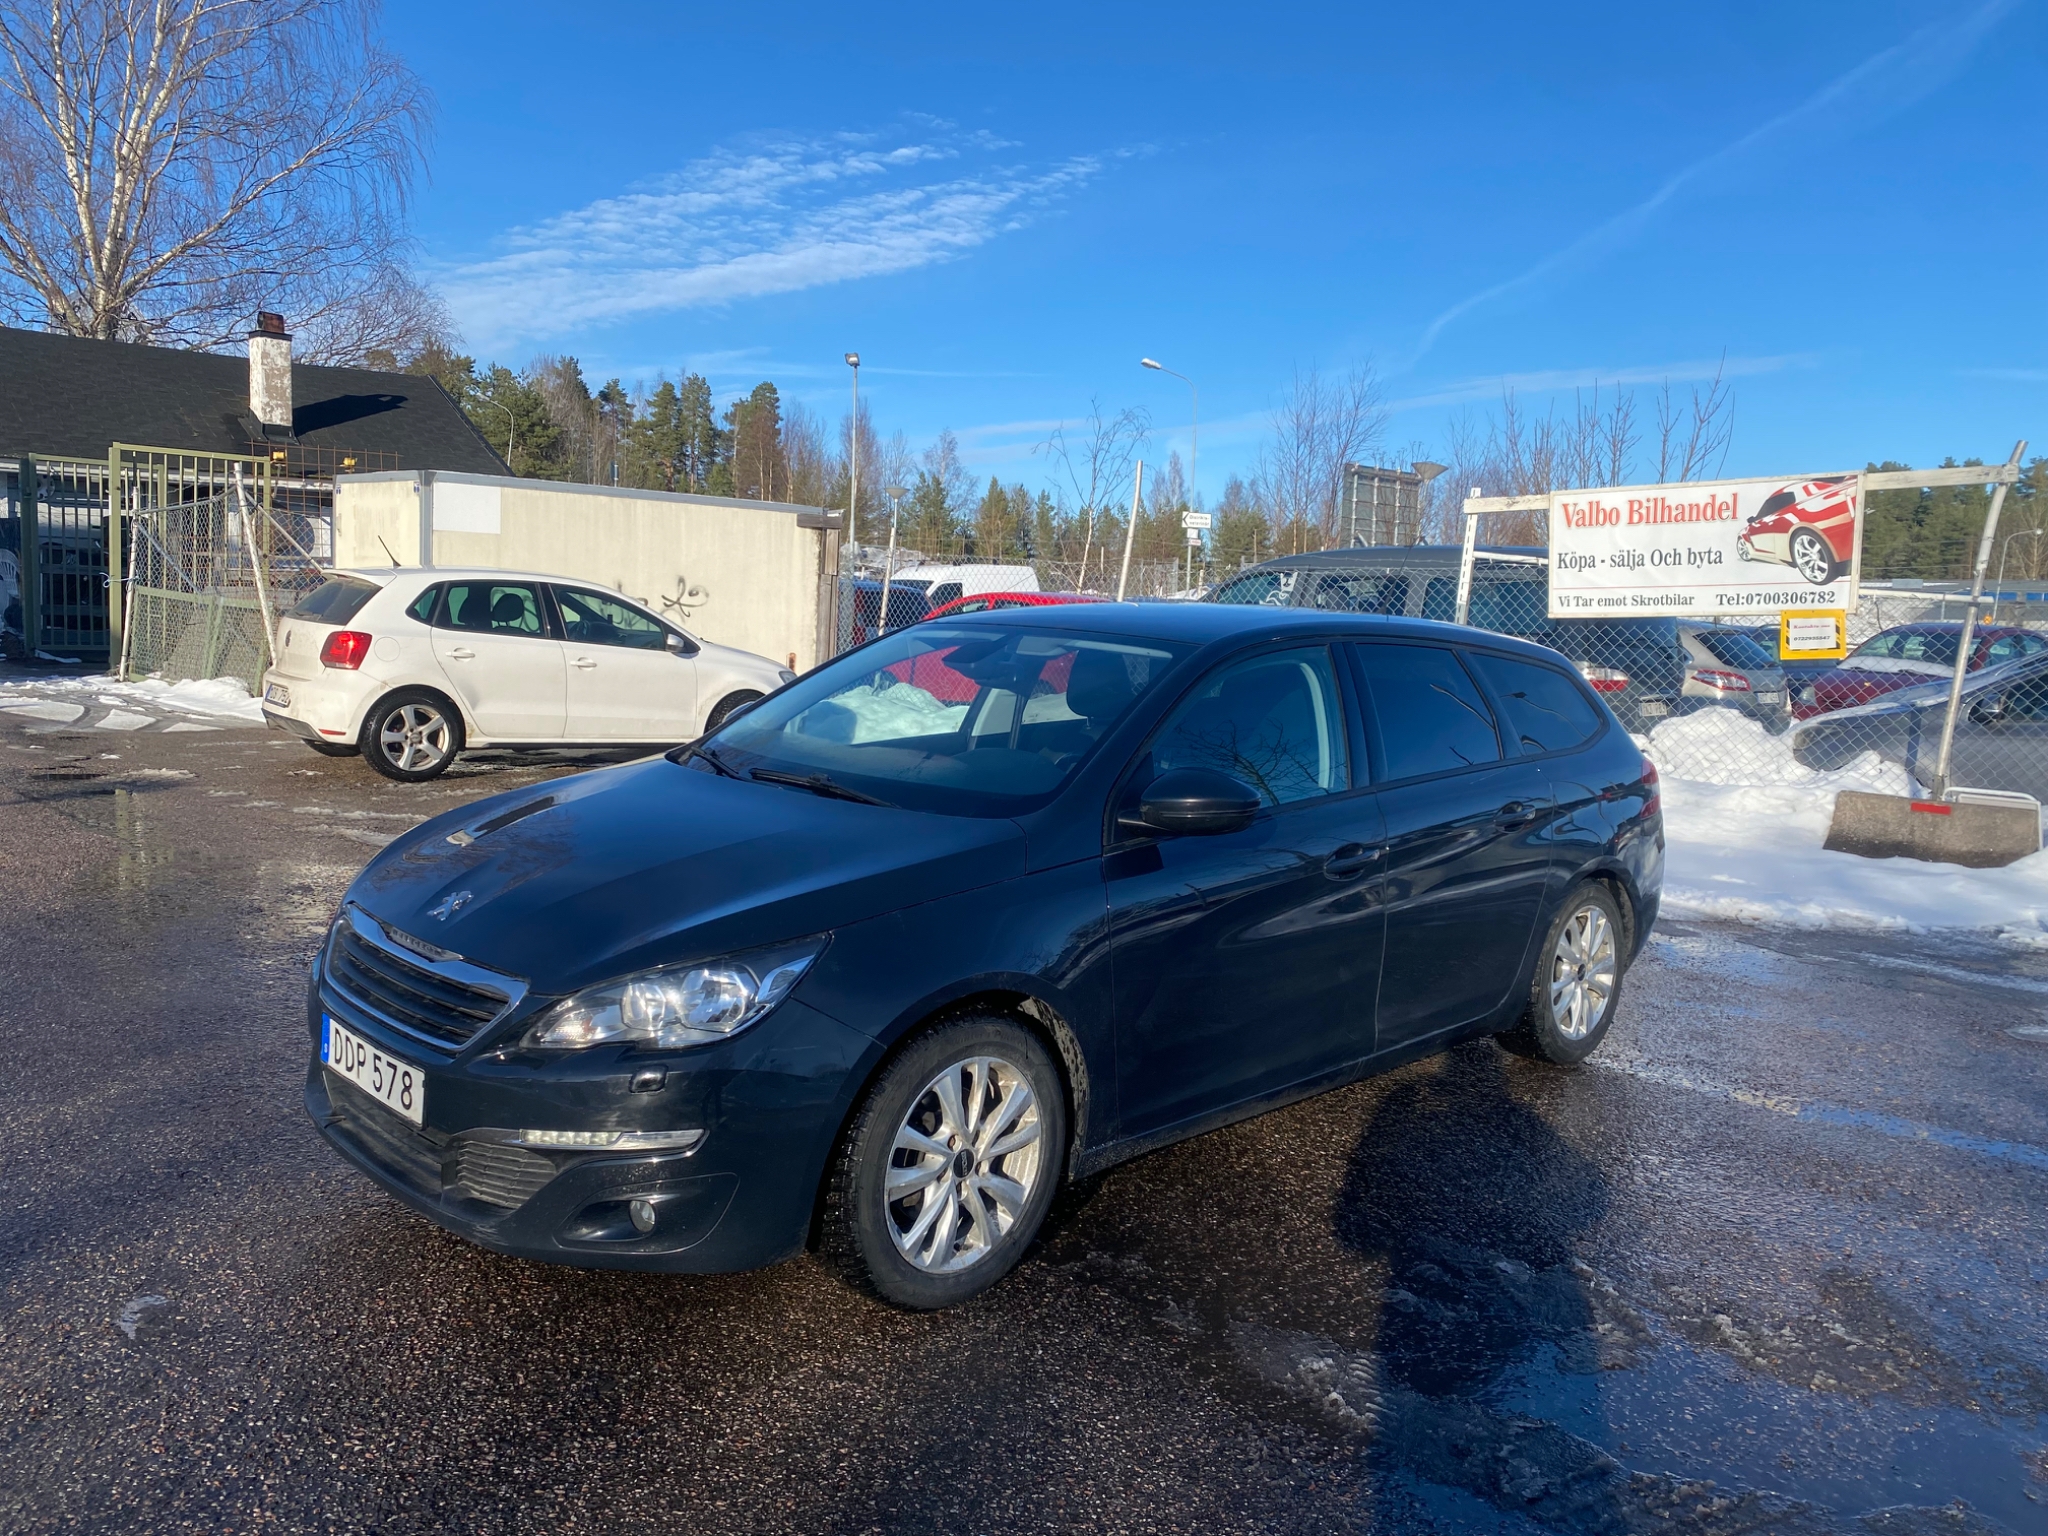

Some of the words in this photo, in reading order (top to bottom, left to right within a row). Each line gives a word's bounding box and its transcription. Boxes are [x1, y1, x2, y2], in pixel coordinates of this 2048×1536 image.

[1562, 500, 1621, 528] Valbo
[1627, 492, 1738, 525] Bilhandel
[1557, 551, 1596, 572] Köpa
[1610, 549, 1645, 571] sälja
[1651, 548, 1683, 567] Och
[1687, 547, 1723, 569] byta
[1558, 595, 1570, 607] Vi
[1573, 595, 1594, 607] Tar
[1597, 595, 1628, 607] emot
[1631, 593, 1695, 606] Skrotbilar
[1716, 590, 1836, 606] Tel:0700306782
[334, 1027, 367, 1079] DDP
[372, 1052, 413, 1110] 578
